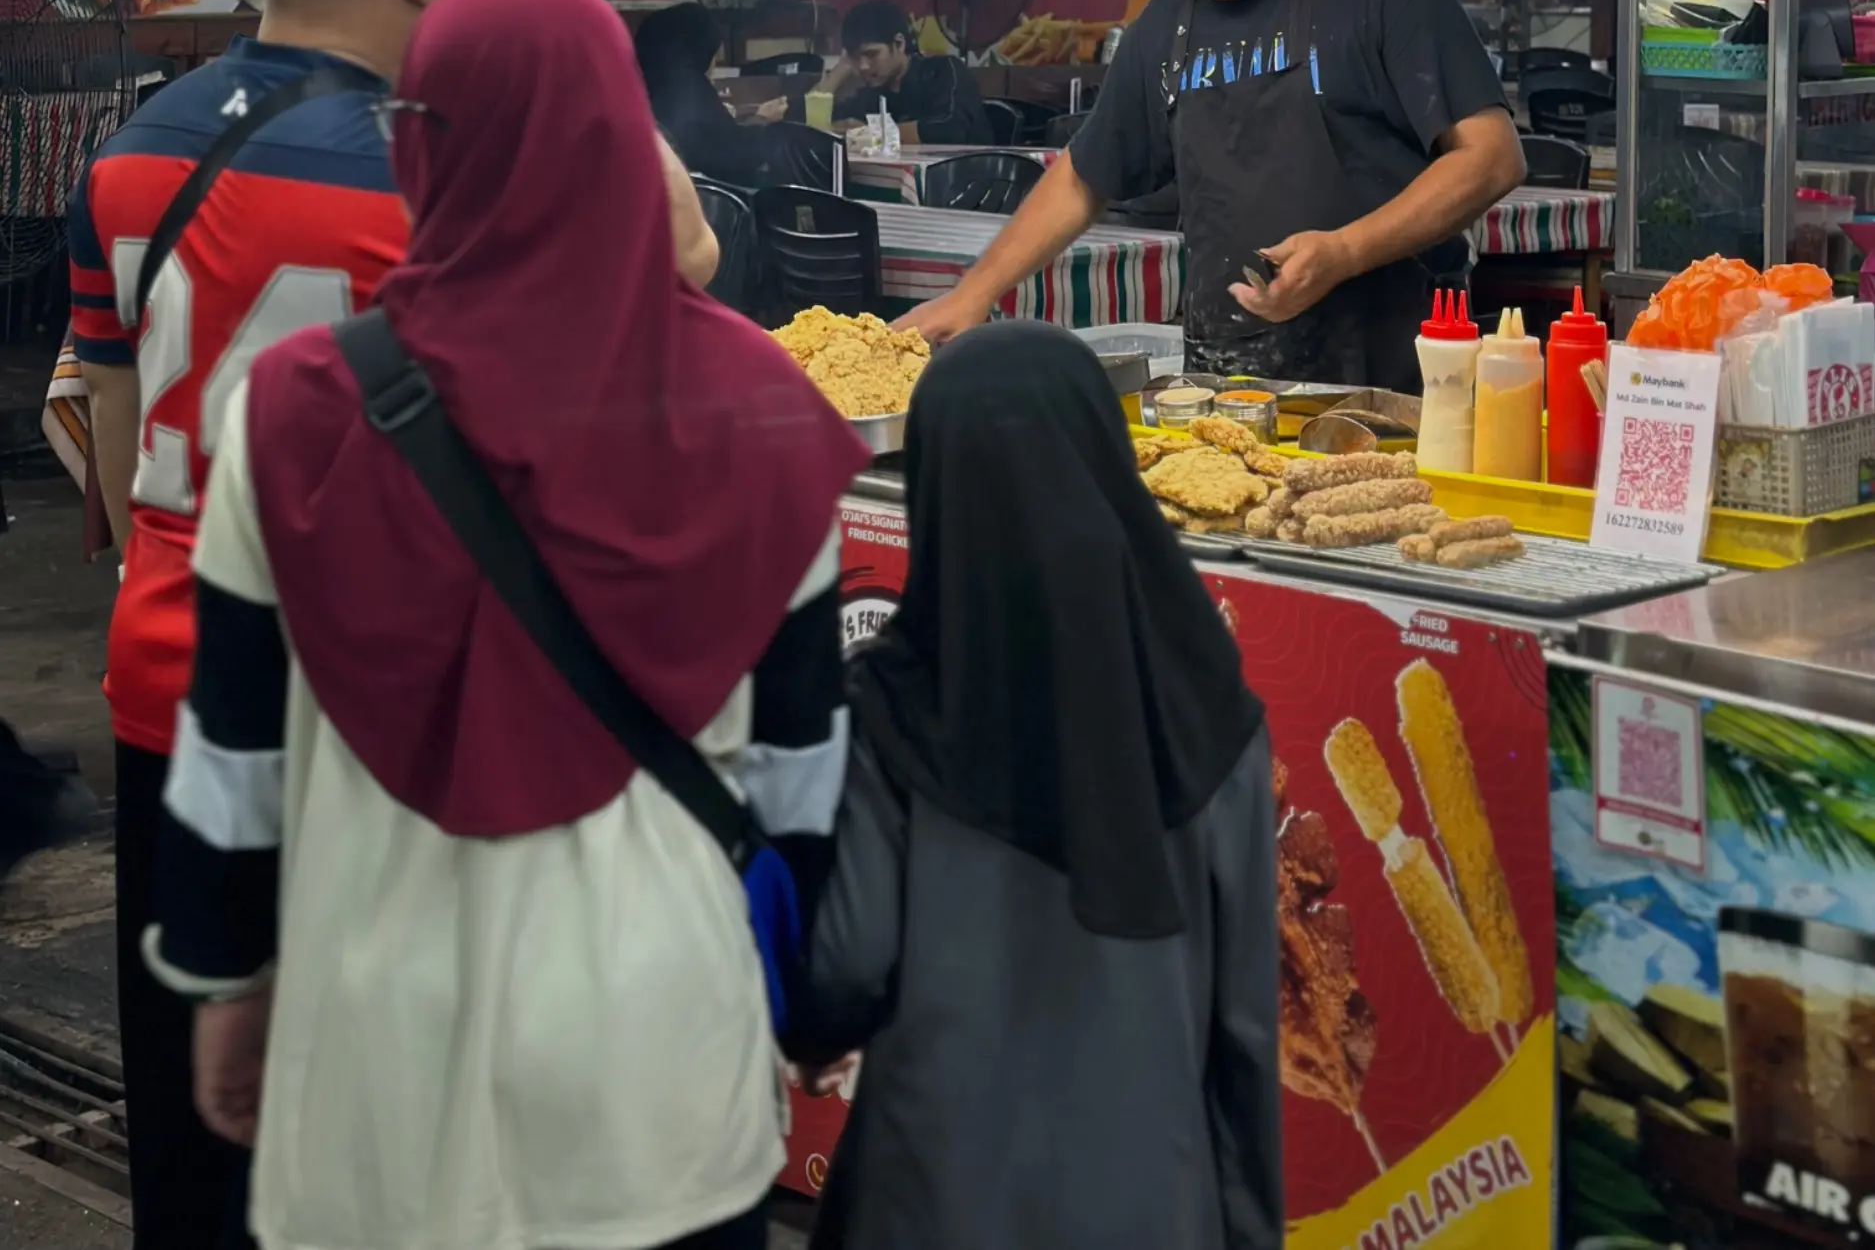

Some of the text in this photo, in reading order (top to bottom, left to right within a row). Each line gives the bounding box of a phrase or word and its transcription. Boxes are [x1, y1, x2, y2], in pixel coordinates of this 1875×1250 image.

[1643, 374, 1686, 390] Maybank
[1616, 393, 1630, 403] Md
[1631, 395, 1649, 405] Zain
[1650, 397, 1665, 407] Bin
[848, 527, 909, 548] FRIED CHICKE
[1412, 614, 1449, 633] FRIED
[1400, 630, 1460, 655] SAUSAGE
[1358, 1136, 1530, 1250] MALAYSIA
[1765, 1161, 1851, 1225] AIR
